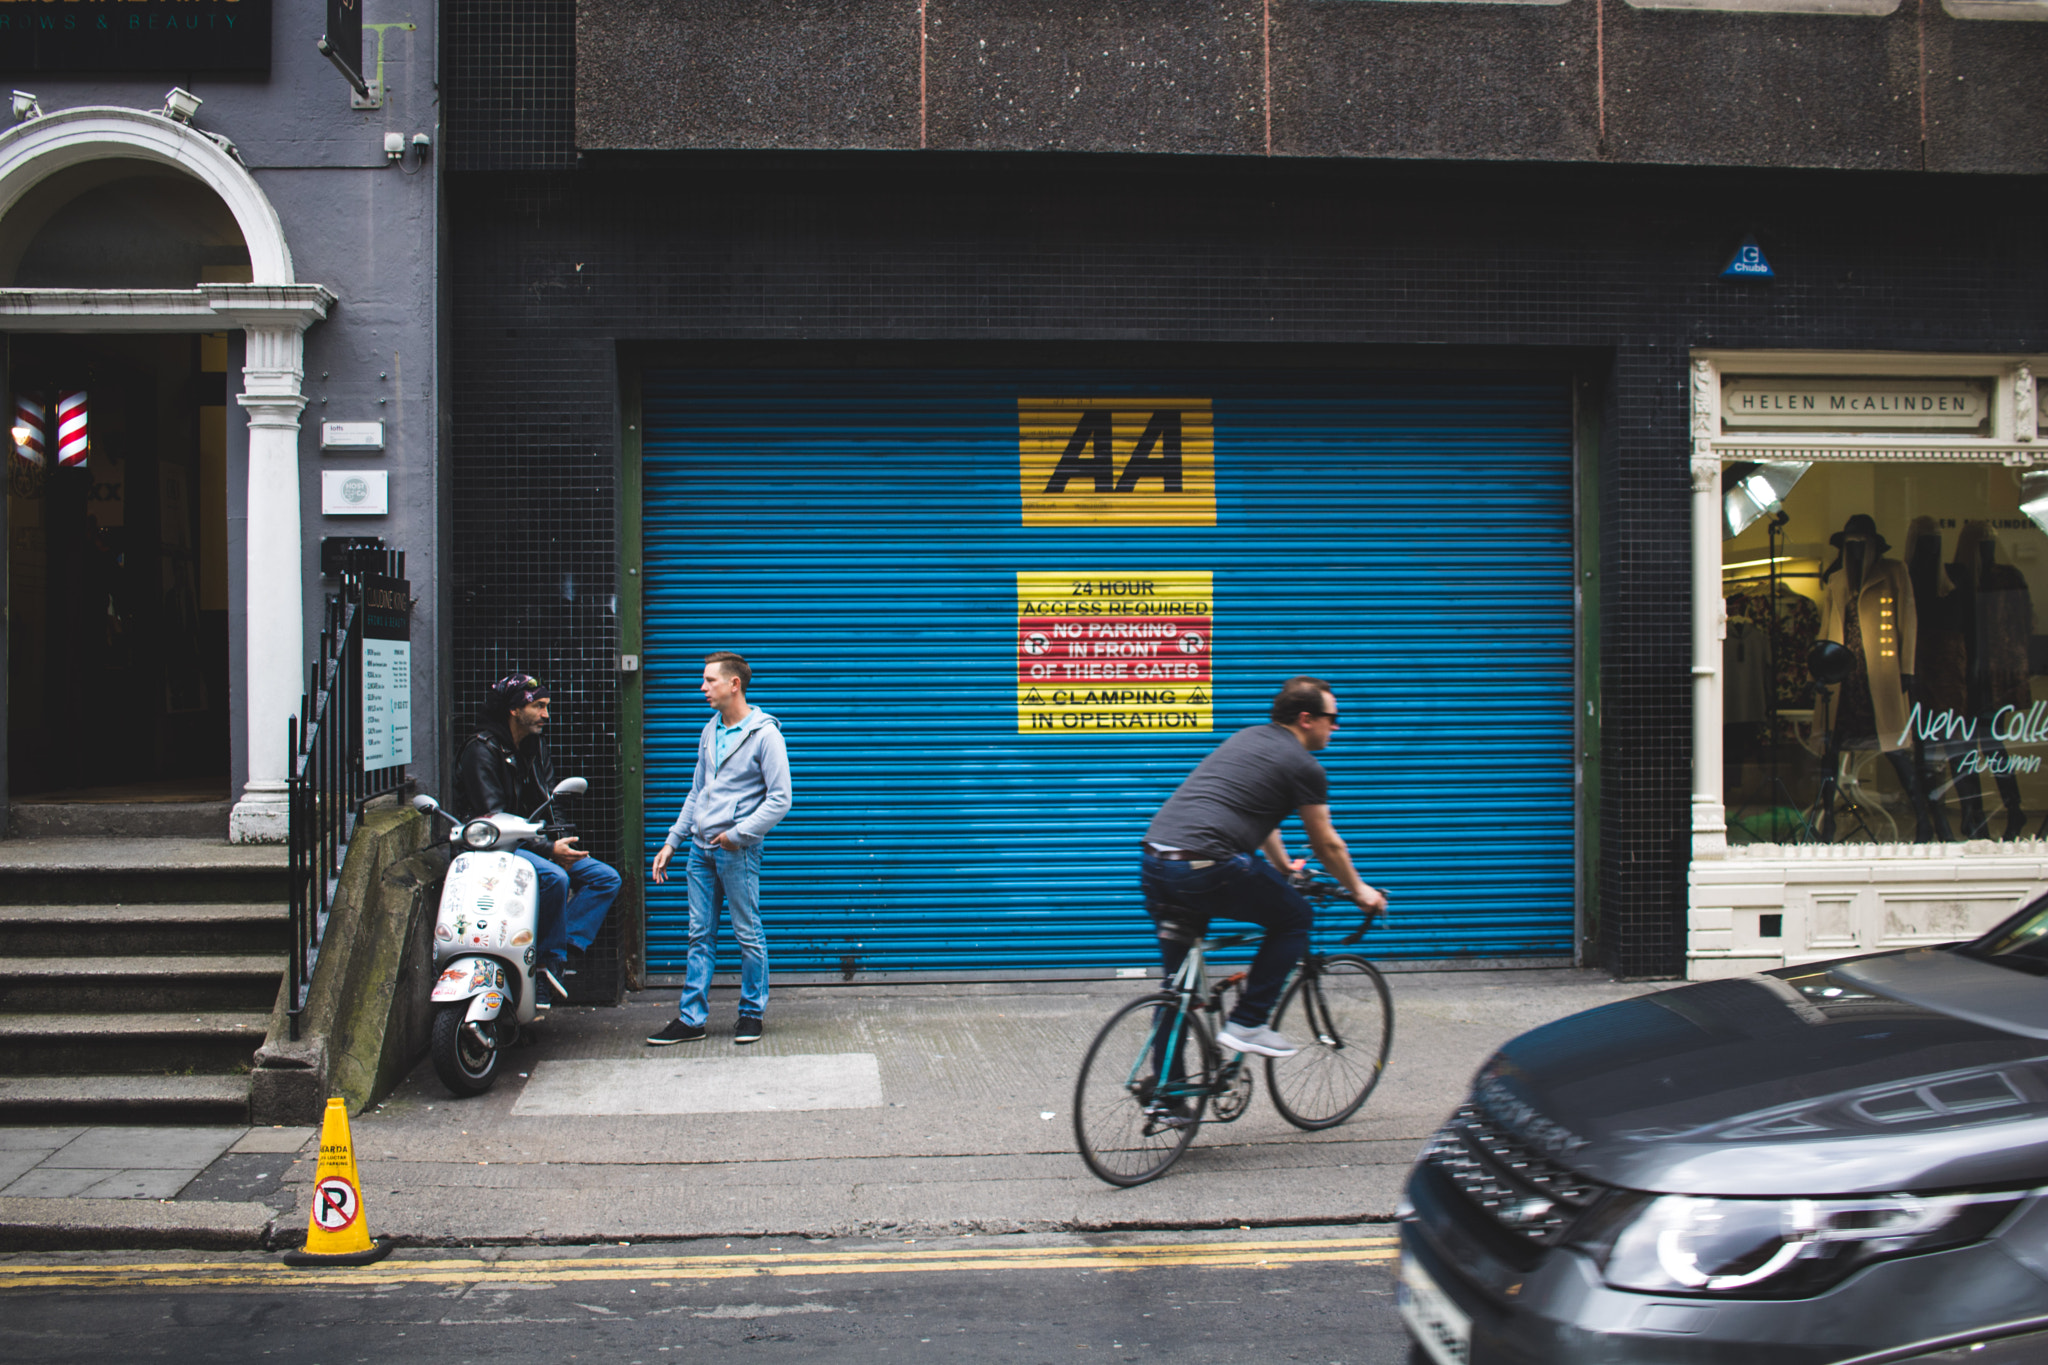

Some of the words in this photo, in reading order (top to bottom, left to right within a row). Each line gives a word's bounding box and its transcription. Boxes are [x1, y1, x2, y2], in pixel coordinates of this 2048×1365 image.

[96, 14, 108, 29] &
[129, 14, 237, 29] BEAUTY
[1735, 263, 1768, 272] Chubb
[1743, 395, 1815, 409] HELEN
[1830, 395, 1965, 411] McALINDEN
[1043, 410, 1183, 493] AA
[346, 482, 365, 490] HOST
[1072, 580, 1093, 596] 24
[1100, 580, 1156, 596] HOUR
[1023, 601, 1102, 615] ACCESS
[1108, 601, 1208, 616] REQUIRED
[1053, 622, 1083, 638] NO
[1088, 622, 1177, 638] PARKING
[1069, 642, 1087, 658] IN
[1094, 642, 1162, 658] FRONT
[1030, 663, 1057, 679] OF
[1062, 663, 1128, 679] THESE
[1133, 663, 1200, 679] GATES
[1052, 690, 1176, 705] CLAMPING
[1031, 713, 1053, 728] IN
[1061, 712, 1198, 728] OPERATION
[1897, 701, 1978, 747] New
[1957, 749, 2042, 774] Autumn
